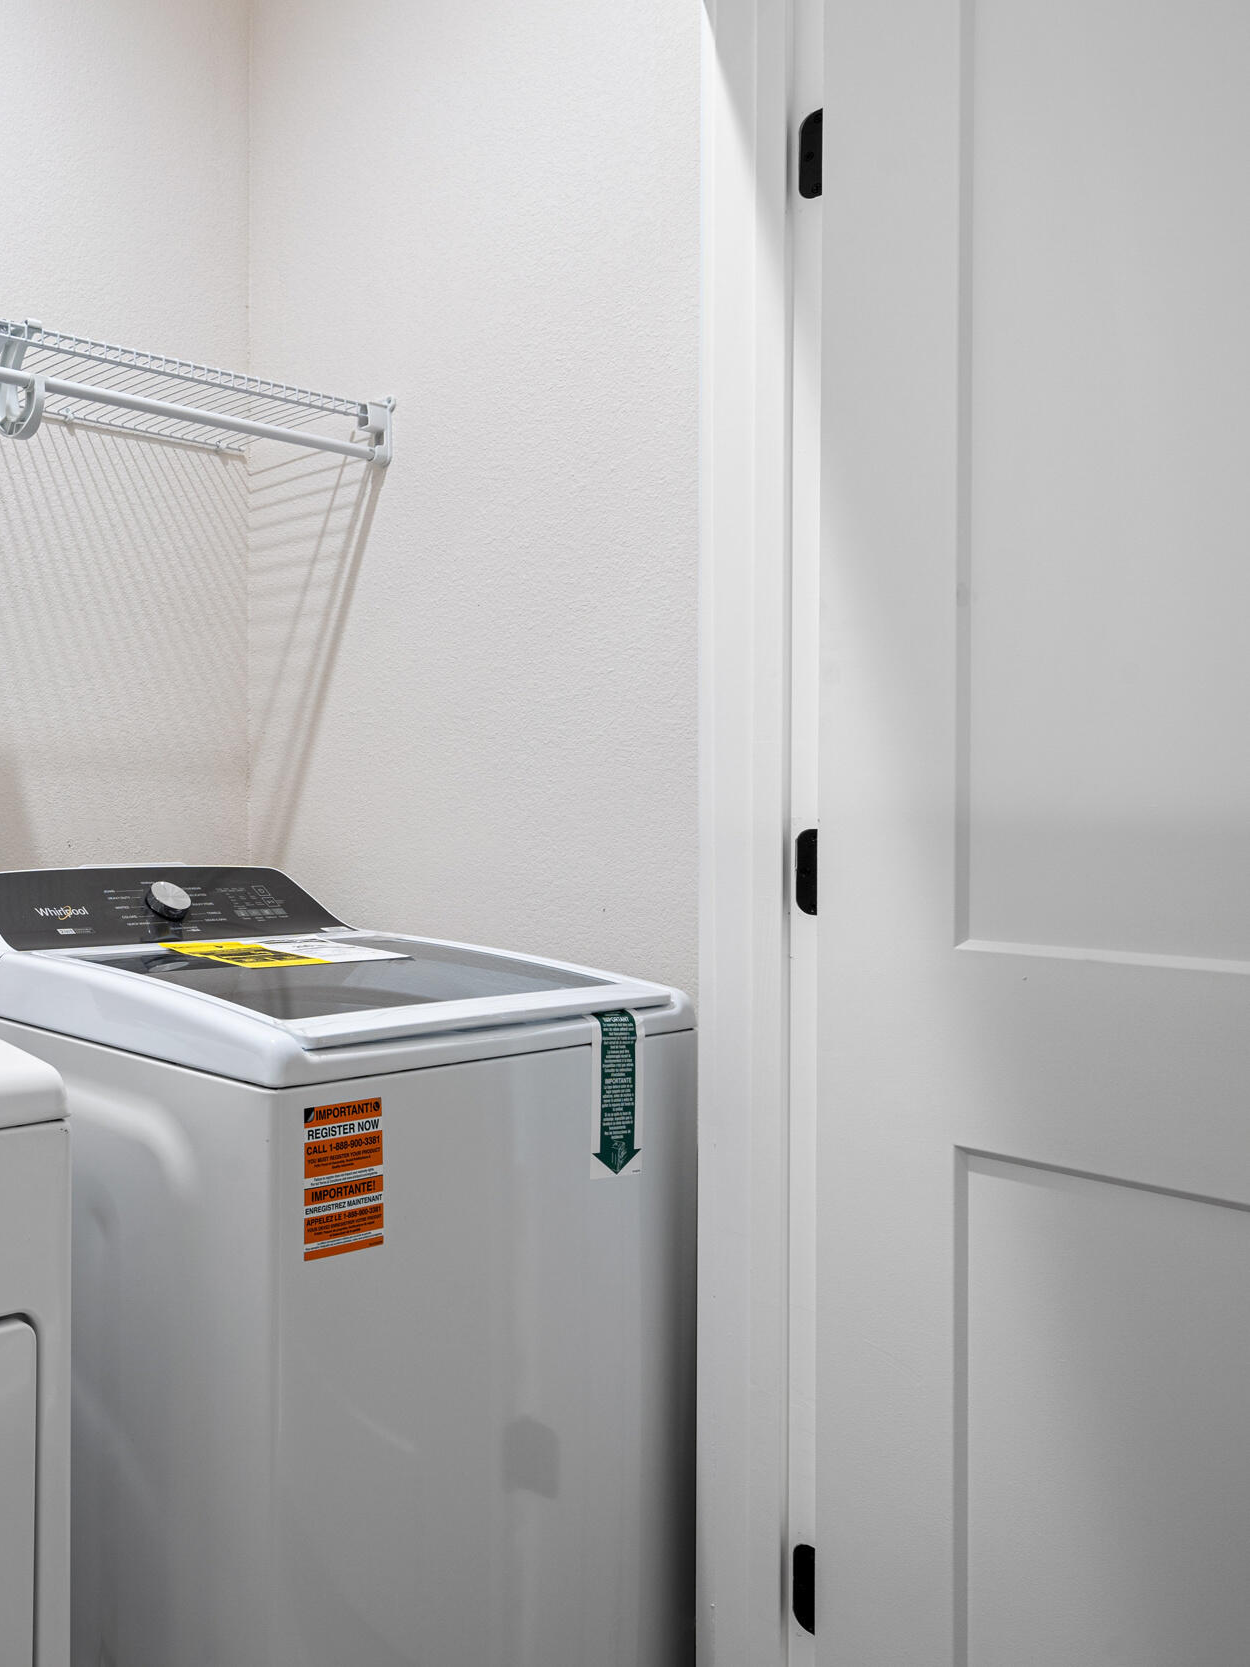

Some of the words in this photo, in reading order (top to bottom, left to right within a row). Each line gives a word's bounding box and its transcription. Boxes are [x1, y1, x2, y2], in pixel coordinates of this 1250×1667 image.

[34, 906, 89, 918] Whirlpool
[316, 1102, 372, 1120] IMPORTANT!
[308, 1123, 355, 1140] REGISTER
[358, 1119, 379, 1132] NOW
[307, 1144, 327, 1155] CALL
[330, 1136, 380, 1151] 1-888-900-3381
[311, 1181, 376, 1202] IMPORTANTE!
[305, 1202, 346, 1215] ENREGISTREZ
[347, 1194, 382, 1206] MAINTENANT
[307, 1216, 333, 1226] APPELEZ
